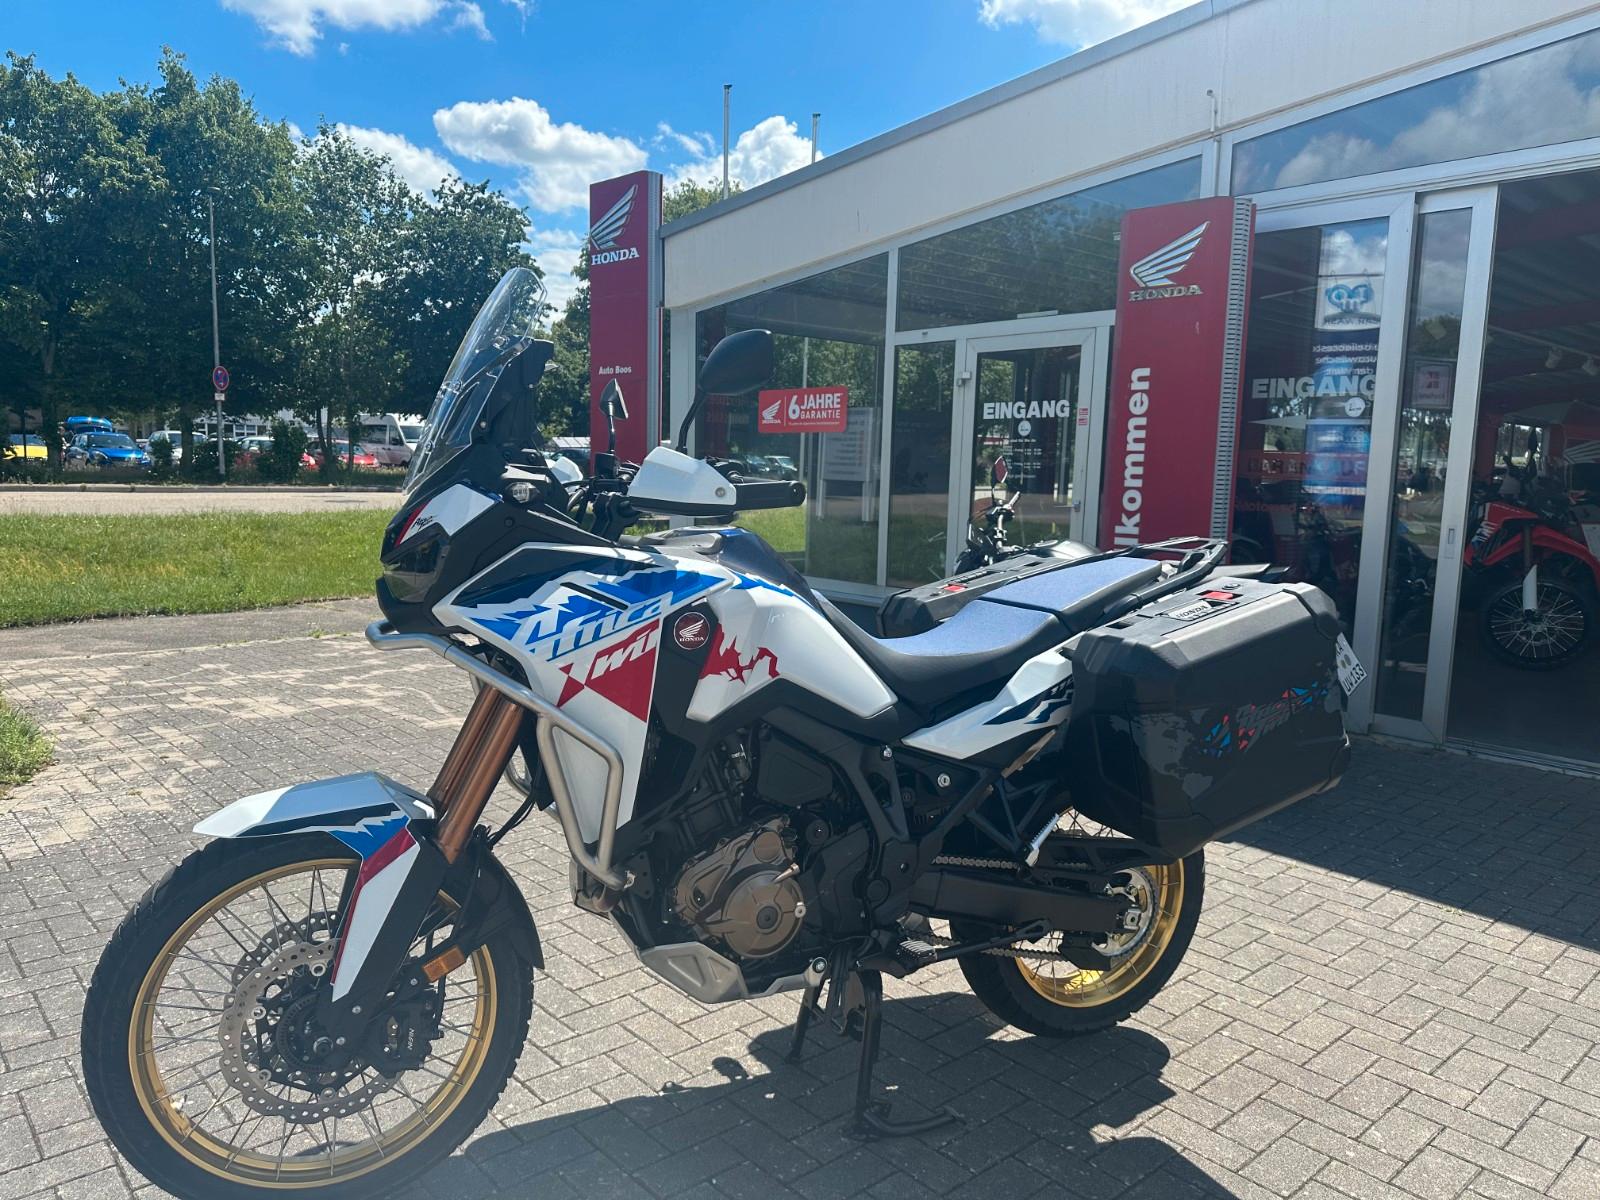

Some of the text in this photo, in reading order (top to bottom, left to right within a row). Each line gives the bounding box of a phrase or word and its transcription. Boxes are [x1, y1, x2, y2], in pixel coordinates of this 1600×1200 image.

[591, 247, 640, 265] HONDA
[1128, 284, 1204, 301] HONDA
[598, 365, 632, 375] Auto Boos
[1251, 375, 1376, 401] EINGANG
[788, 393, 841, 420] 6 JAHRE
[800, 409, 841, 419] GARANTIE
[983, 399, 1070, 419] EINGANG
[511, 590, 674, 657] Africa
